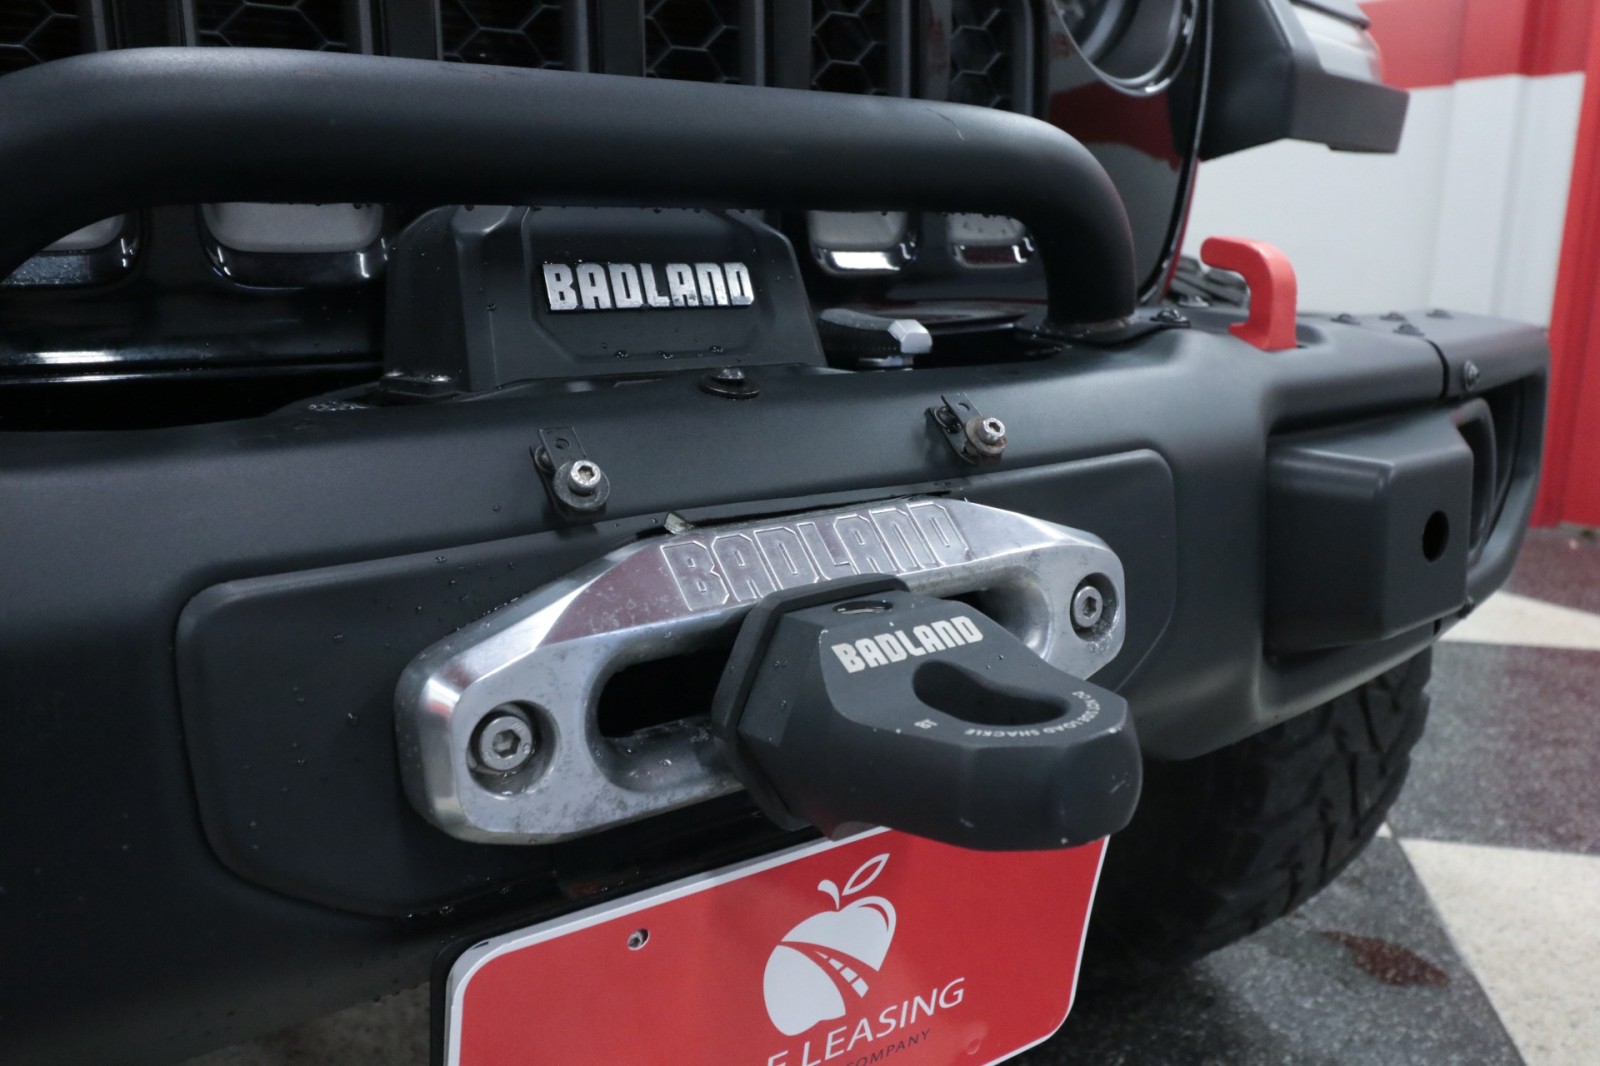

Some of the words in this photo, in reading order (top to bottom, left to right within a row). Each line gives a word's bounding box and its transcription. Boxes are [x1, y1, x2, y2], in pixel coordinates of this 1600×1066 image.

[542, 262, 755, 311] BADLAND
[659, 501, 972, 611] BADLAND
[832, 616, 984, 674] BADLAND
[964, 728, 1040, 737] SHACKLE
[801, 977, 965, 1066] LEASING
